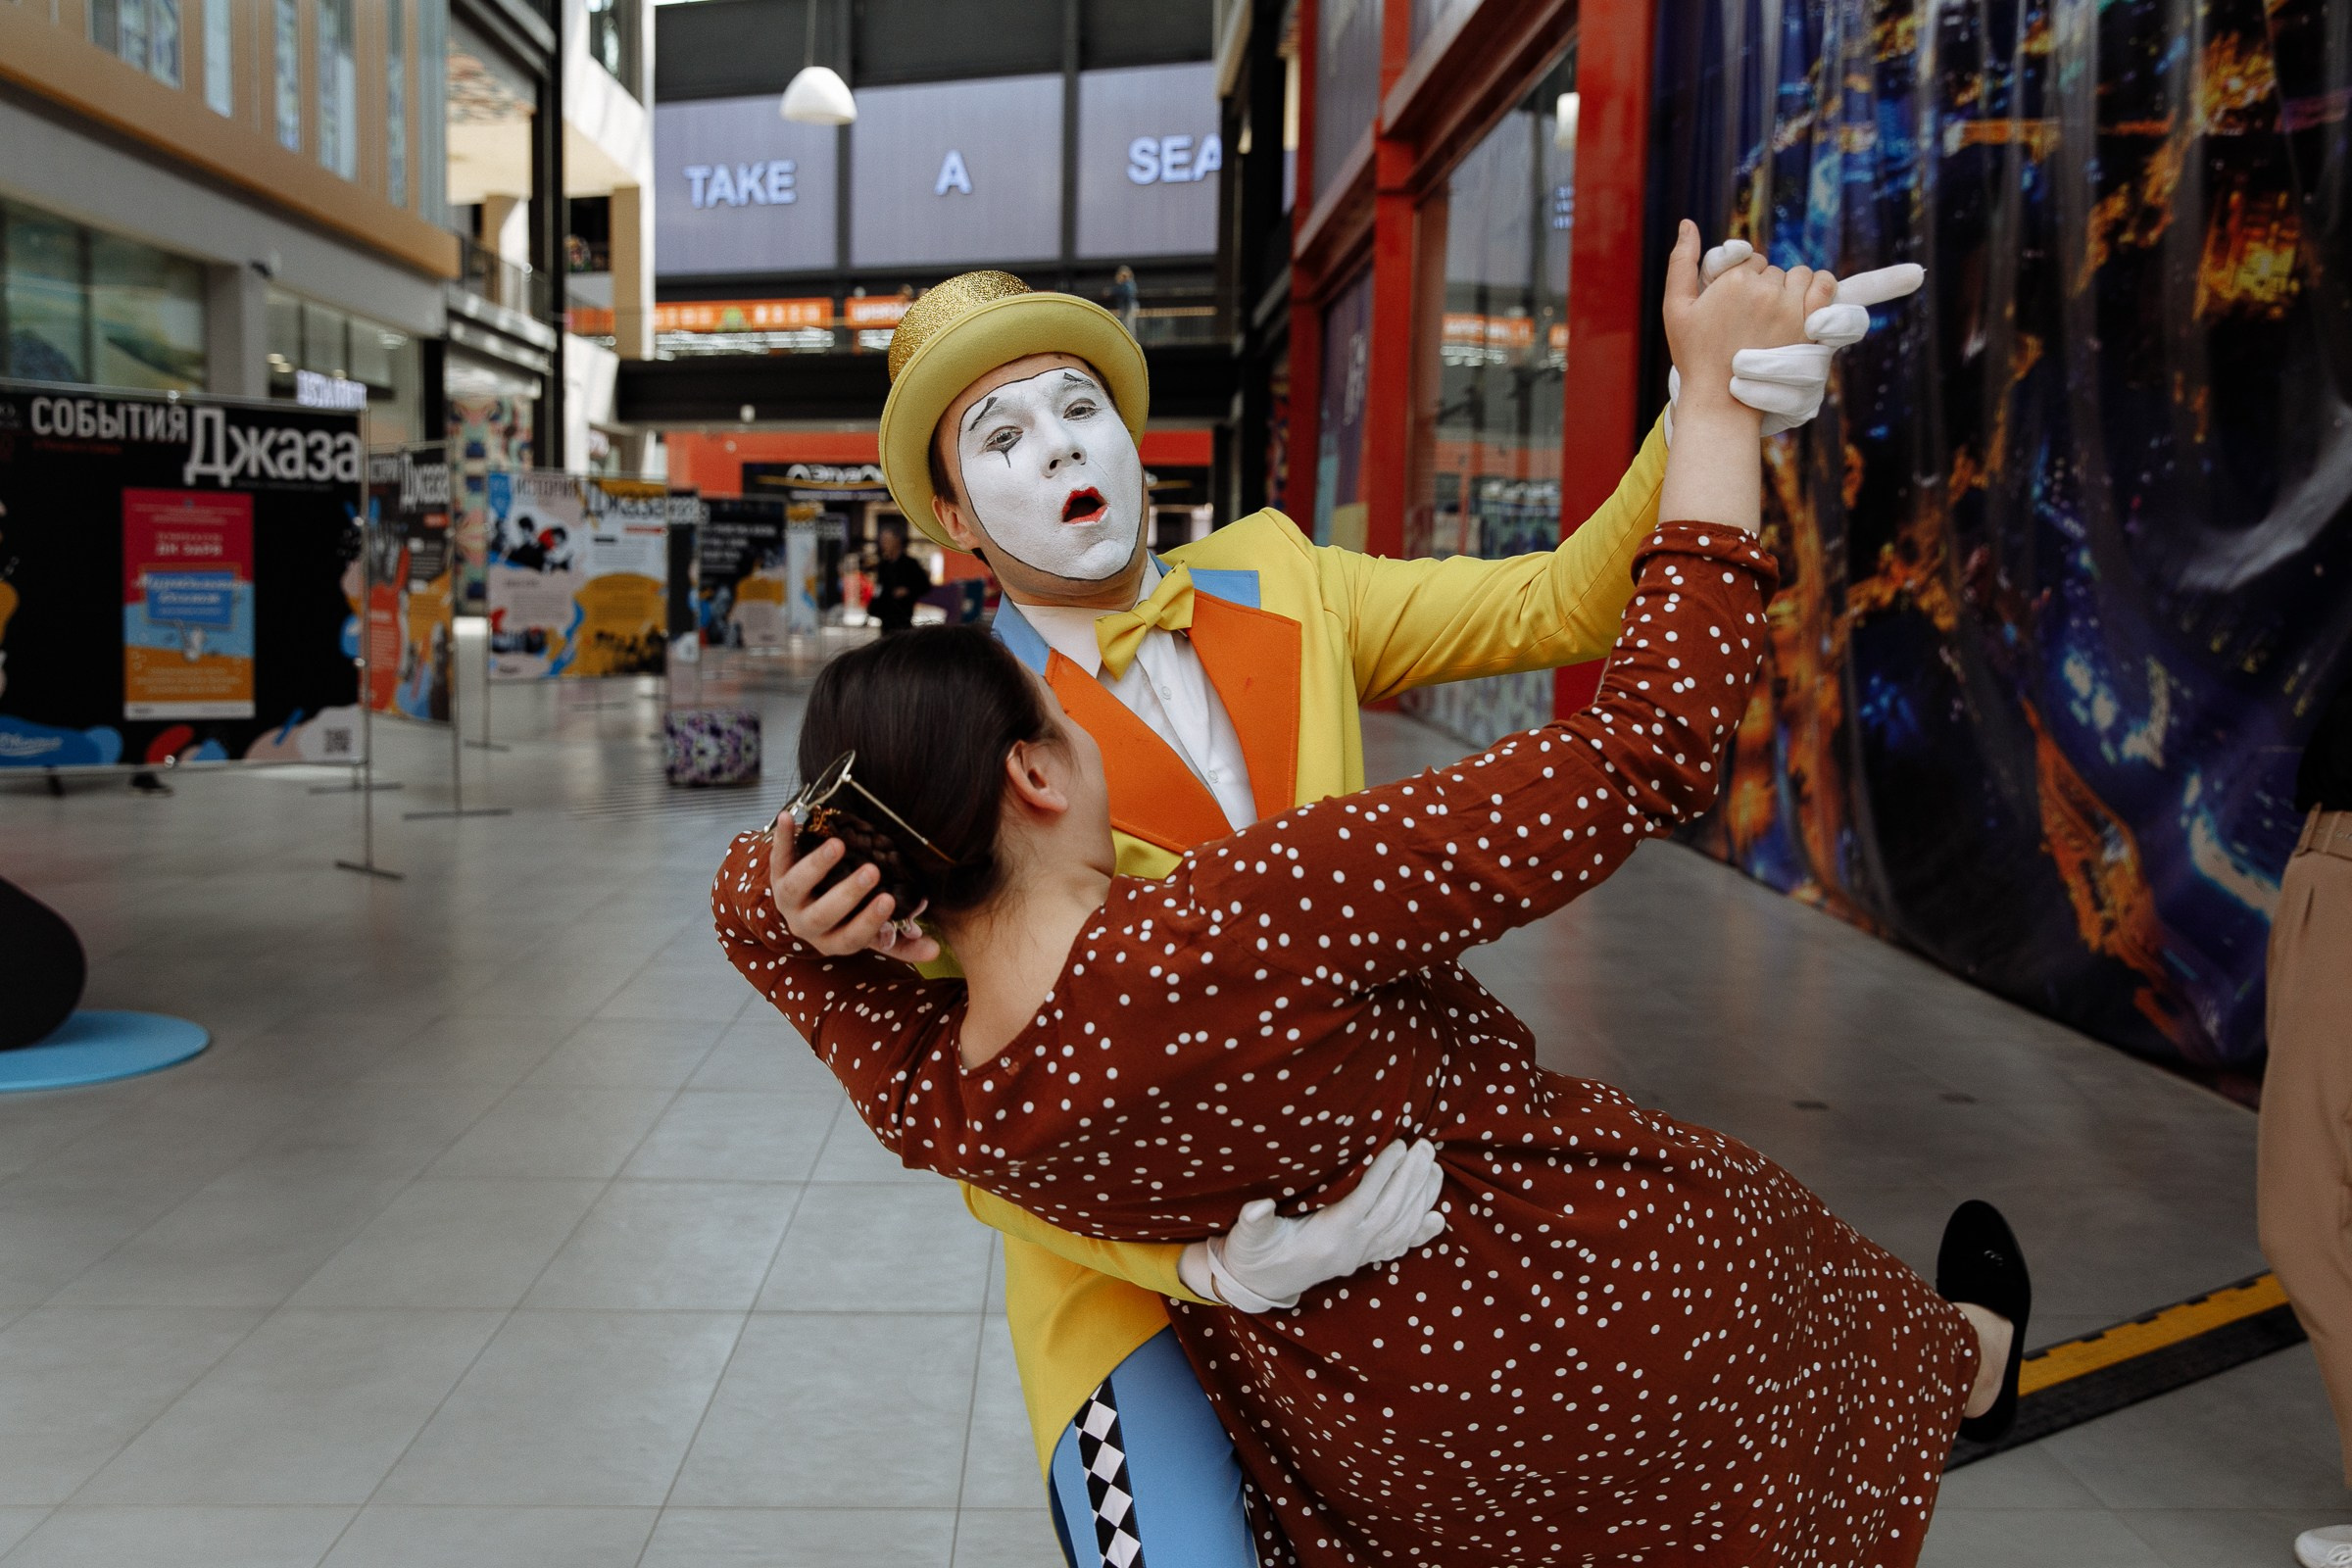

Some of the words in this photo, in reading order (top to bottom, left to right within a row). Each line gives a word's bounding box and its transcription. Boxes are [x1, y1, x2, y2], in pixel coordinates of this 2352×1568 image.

[683, 159, 798, 210] TAKE
[933, 148, 973, 197] A
[30, 396, 188, 443] СОБЫТИЯ
[183, 406, 362, 487] Джаза
